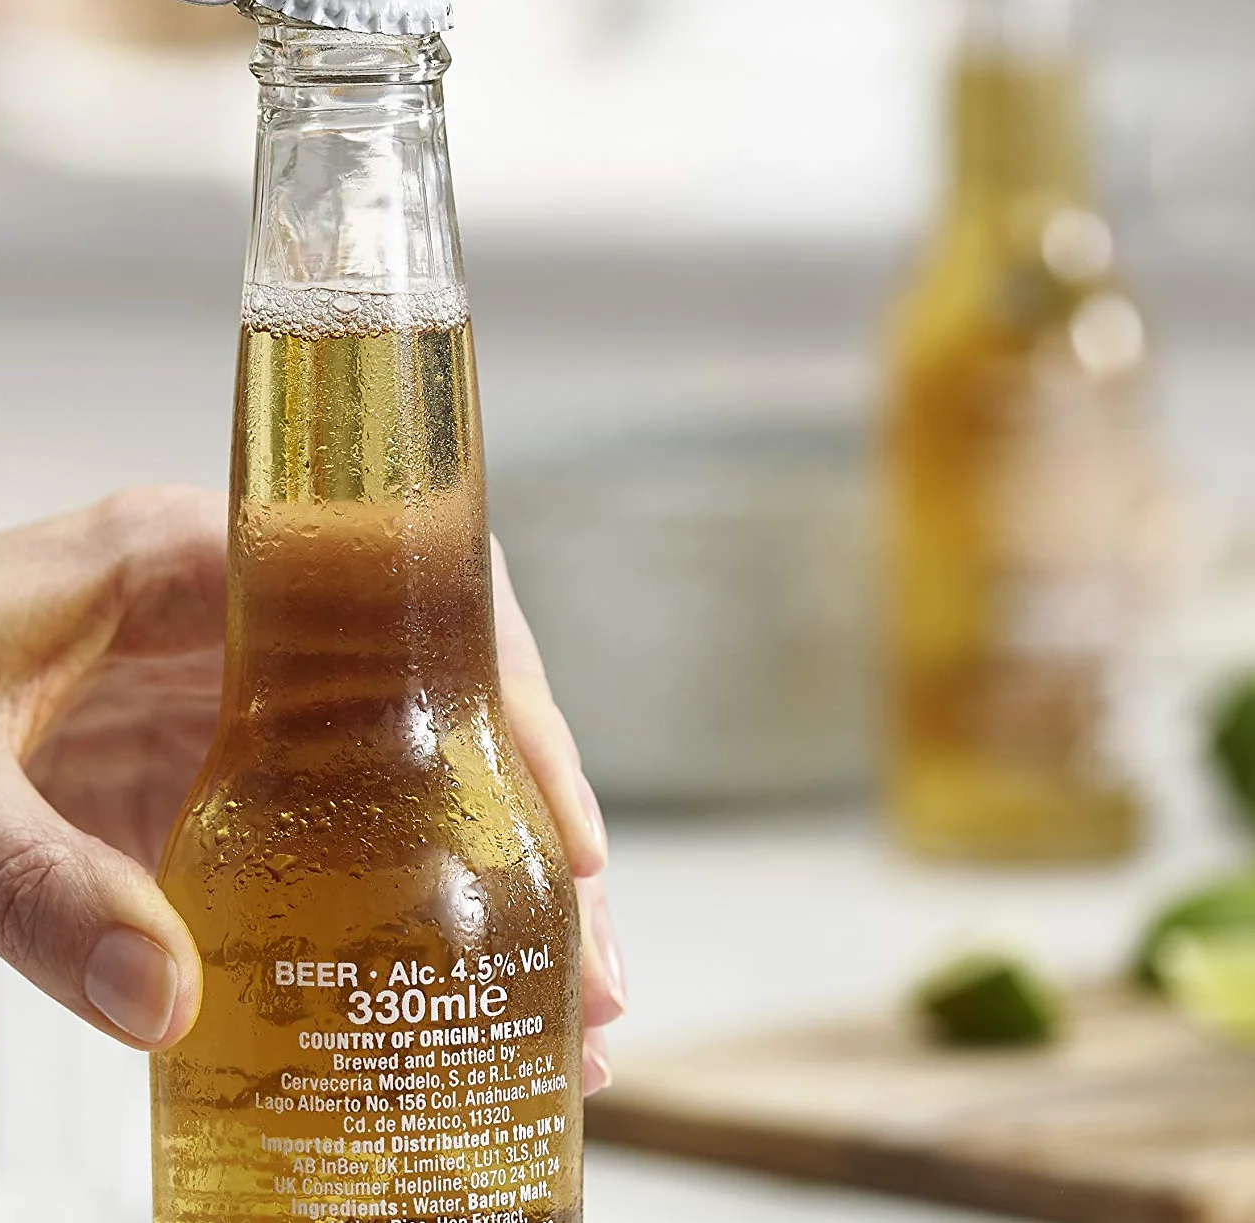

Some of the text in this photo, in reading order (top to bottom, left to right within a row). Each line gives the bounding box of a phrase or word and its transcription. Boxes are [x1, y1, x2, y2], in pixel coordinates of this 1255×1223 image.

[275, 944, 554, 987] BEER Alc. 4.5% Vol.
[299, 1015, 543, 1050] COUNTRY OF ORIGIN: MEXICO
[281, 1054, 554, 1092] Cervecería Modelo, S. de R.L. de C.V.
[333, 1044, 521, 1071] Brewed and bottled by:
[255, 1073, 568, 1115] Lago Alberto No. 156 Col. Anáhuac, México,
[261, 1114, 566, 1156] Imported and Distributed in the UK by
[343, 1105, 515, 1133] Cd. de México, 11320.
[293, 1157, 316, 1174] AB
[321, 1157, 369, 1175] InBev
[374, 1157, 398, 1174] UK
[403, 1151, 471, 1174] Limited,
[474, 1148, 500, 1168] LU1
[534, 1138, 550, 1159] UK
[274, 1156, 560, 1197] UK Consumer Helpline: 0870 24 111 24
[413, 1197, 465, 1214] Water,
[468, 1189, 516, 1211] Barley
[520, 1181, 552, 1203] Malt,
